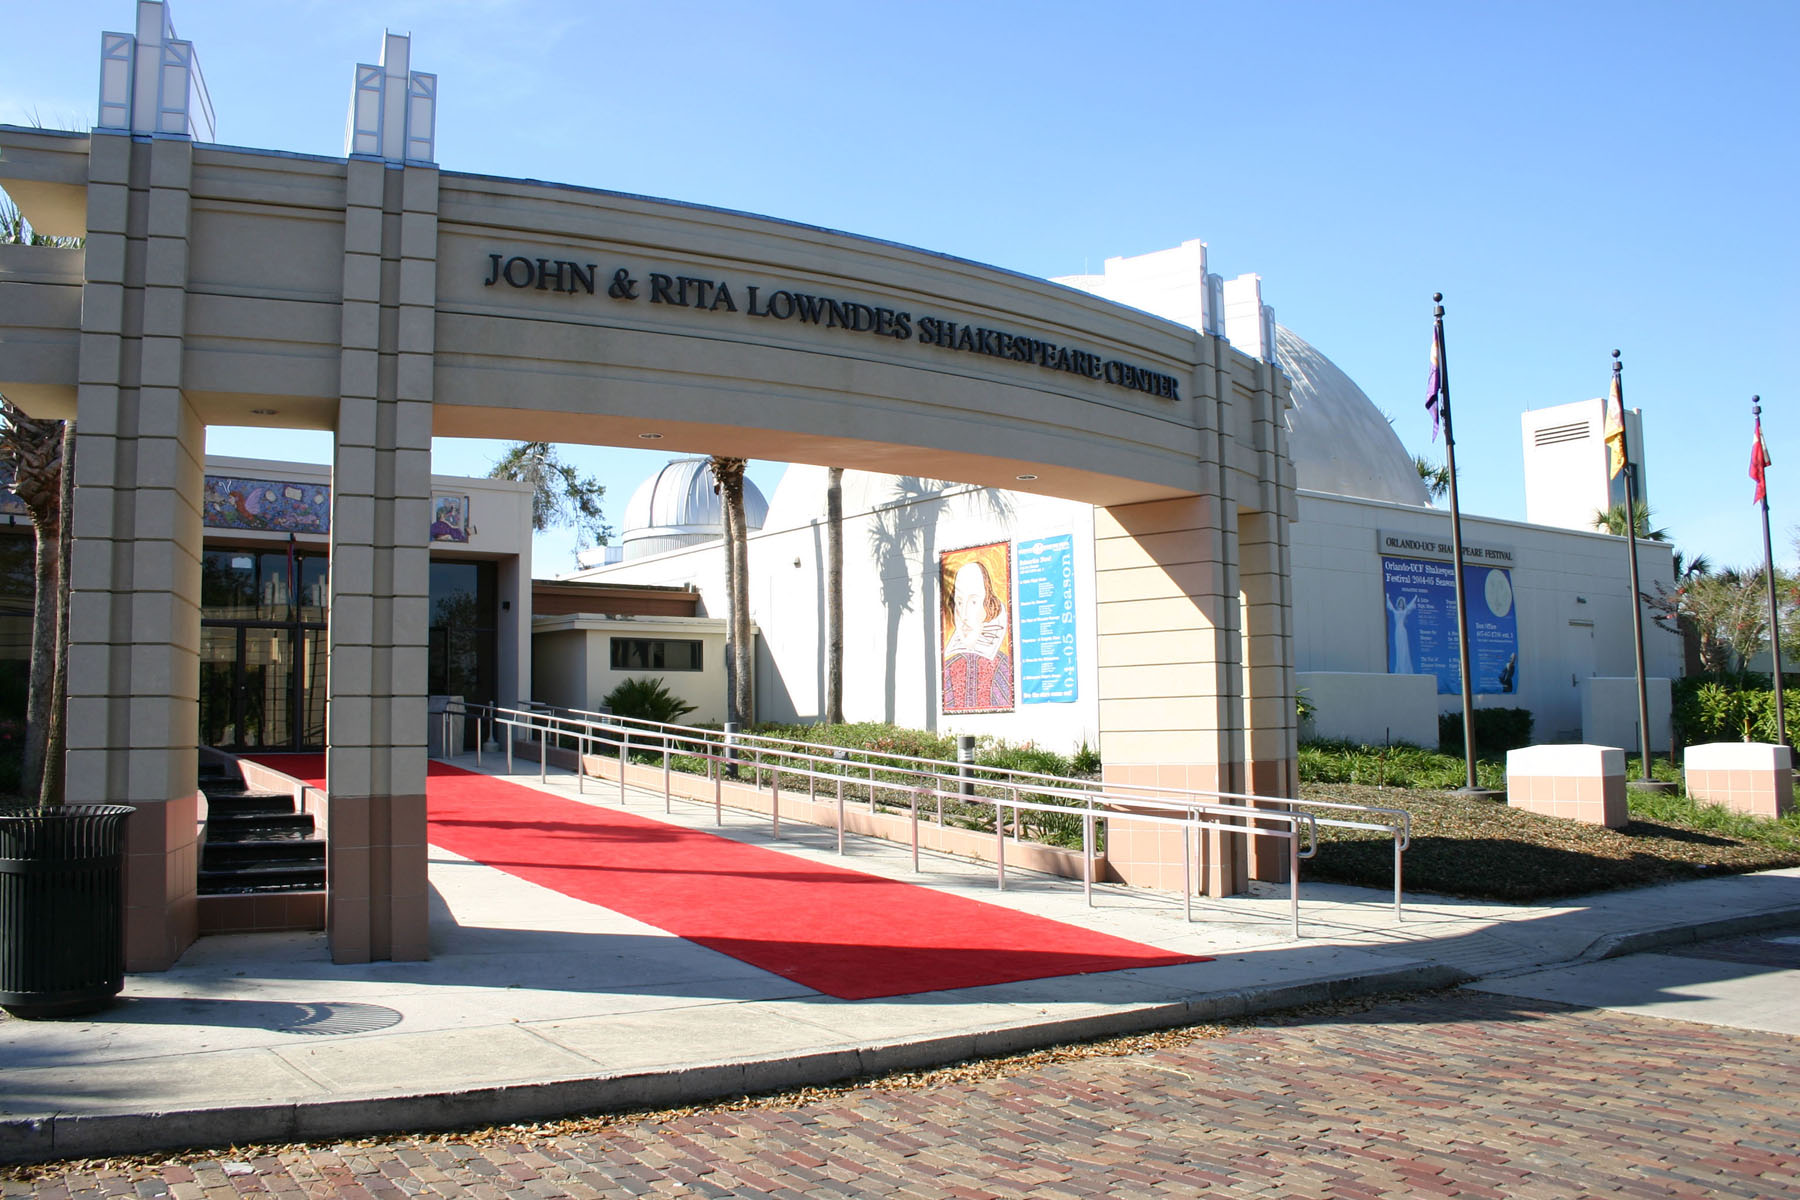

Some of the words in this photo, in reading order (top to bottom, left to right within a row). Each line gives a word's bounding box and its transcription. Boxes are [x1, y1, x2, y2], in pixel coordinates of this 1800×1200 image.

[485, 254, 597, 295] JOHN
[608, 268, 639, 300] &
[650, 272, 737, 313] RITA
[747, 286, 912, 339] LOWNDES
[917, 316, 1102, 380] SHAKESPEARE
[1105, 360, 1180, 401] CENTER
[1385, 537, 1436, 551] ORLANDO-UCF
[1485, 549, 1513, 560] FESTIVAL
[1061, 553, 1073, 624] Season
